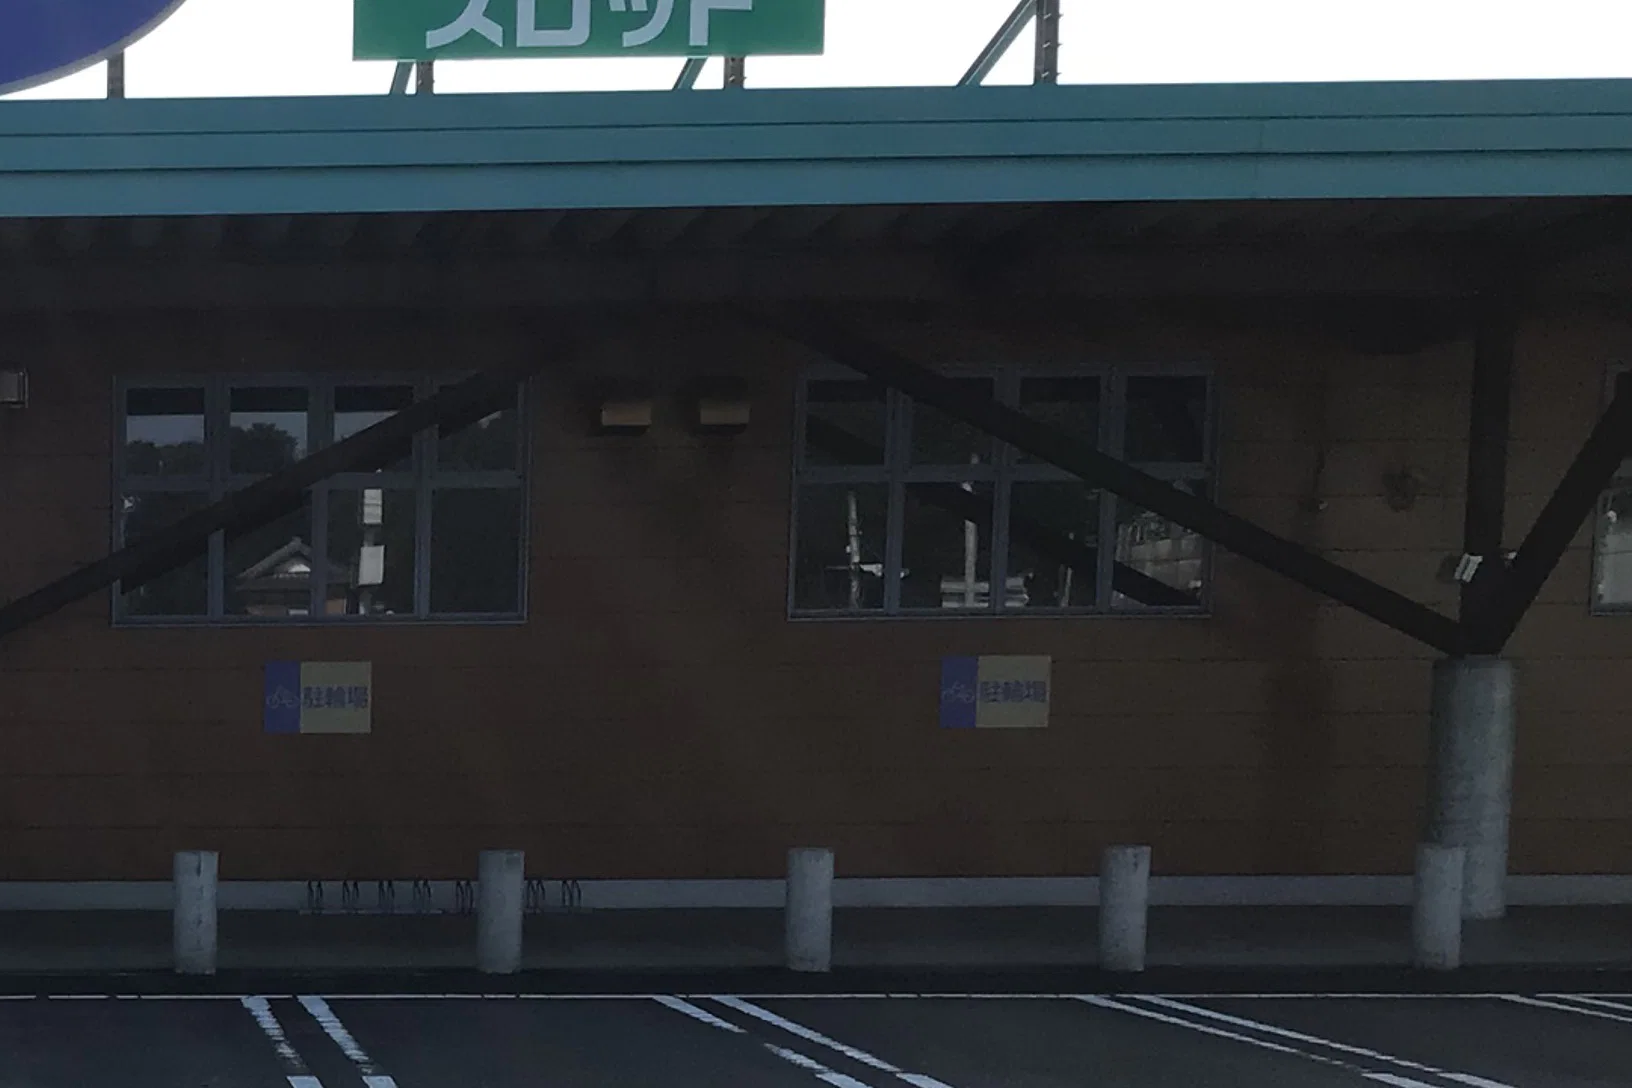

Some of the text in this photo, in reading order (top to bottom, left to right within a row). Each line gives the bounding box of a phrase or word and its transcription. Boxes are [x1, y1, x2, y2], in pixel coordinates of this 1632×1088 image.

[303, 685, 369, 709] 駐輪場
[980, 680, 1047, 703] 駐輪場
